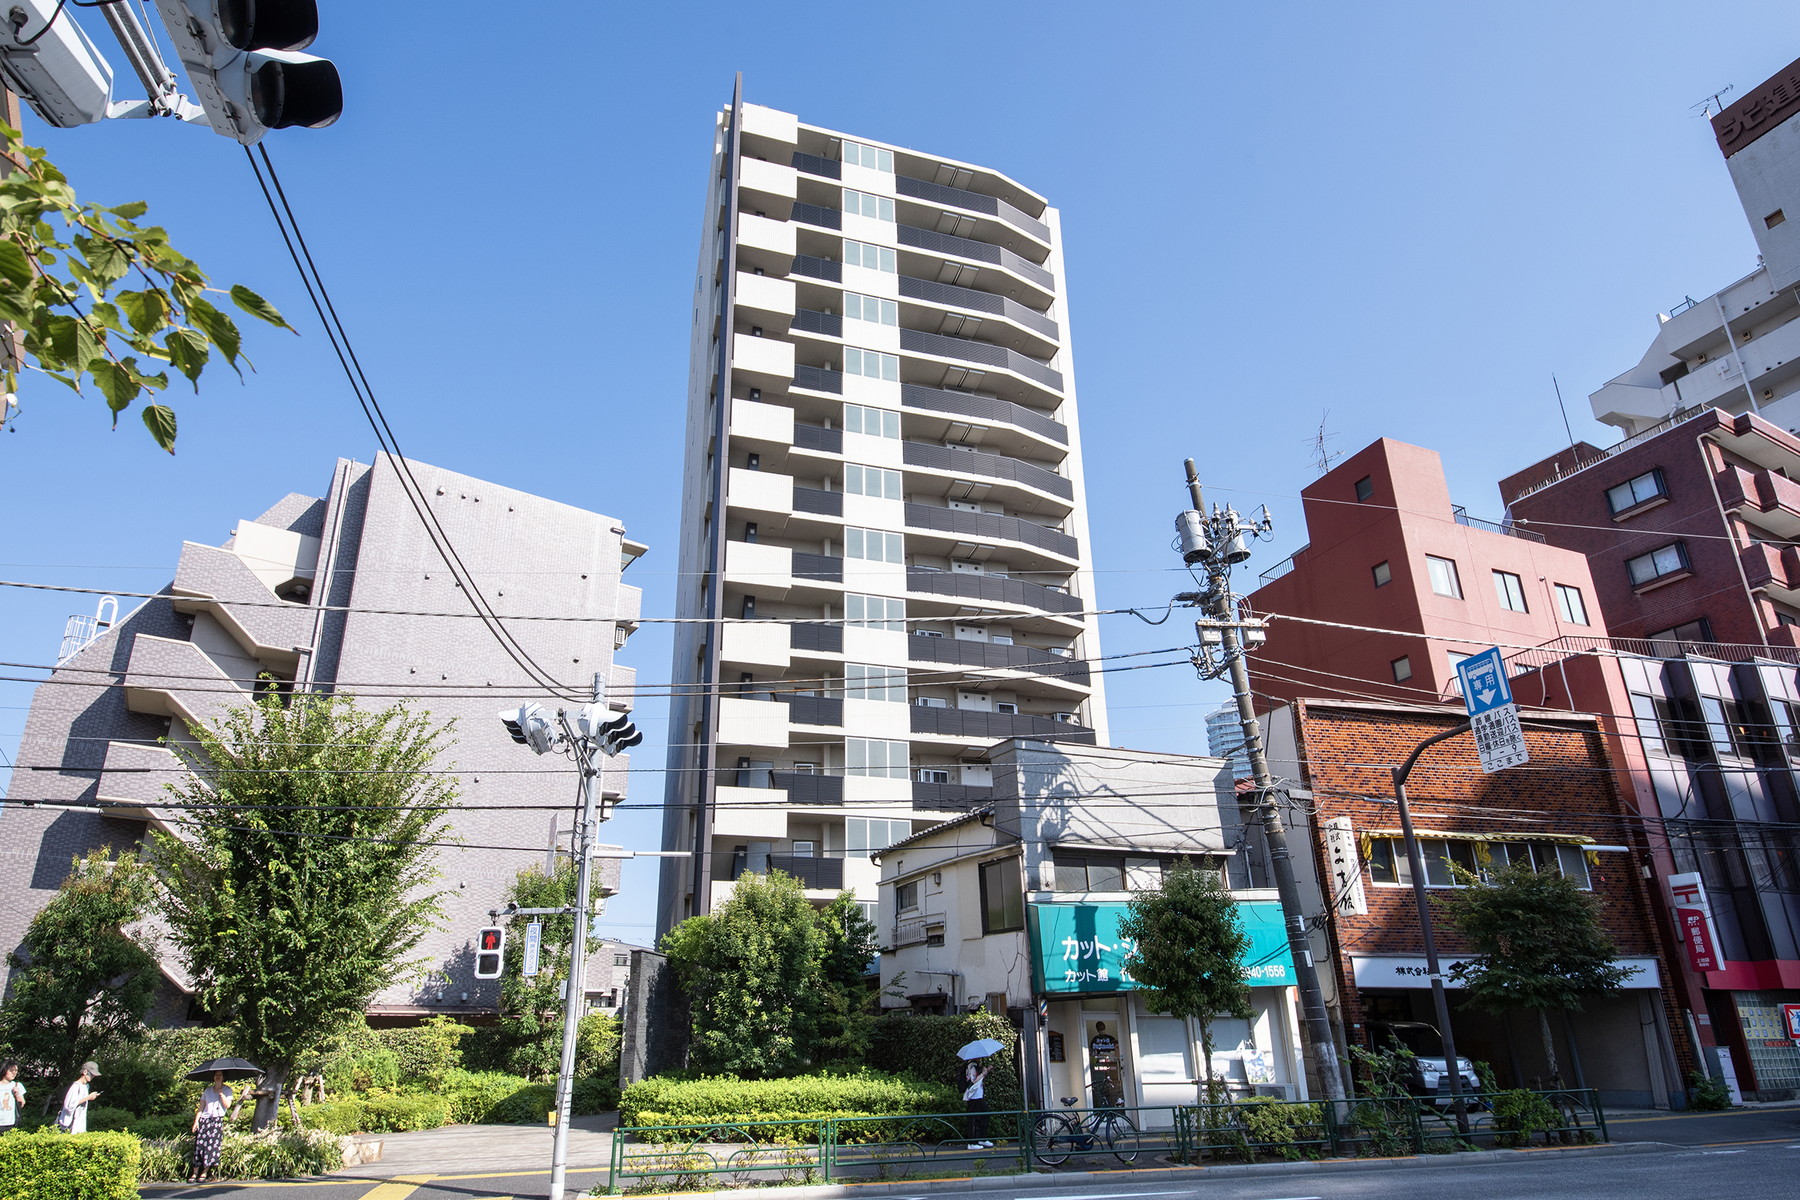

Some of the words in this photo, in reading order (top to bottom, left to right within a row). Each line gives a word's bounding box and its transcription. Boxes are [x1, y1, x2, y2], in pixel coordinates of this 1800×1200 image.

[1473, 674, 1495, 690] 専用
[1475, 708, 1511, 726] 路線バス
[1487, 753, 1523, 771] ここまで
[1690, 927, 1705, 954] 郵便局
[1065, 968, 1109, 983] カット館
